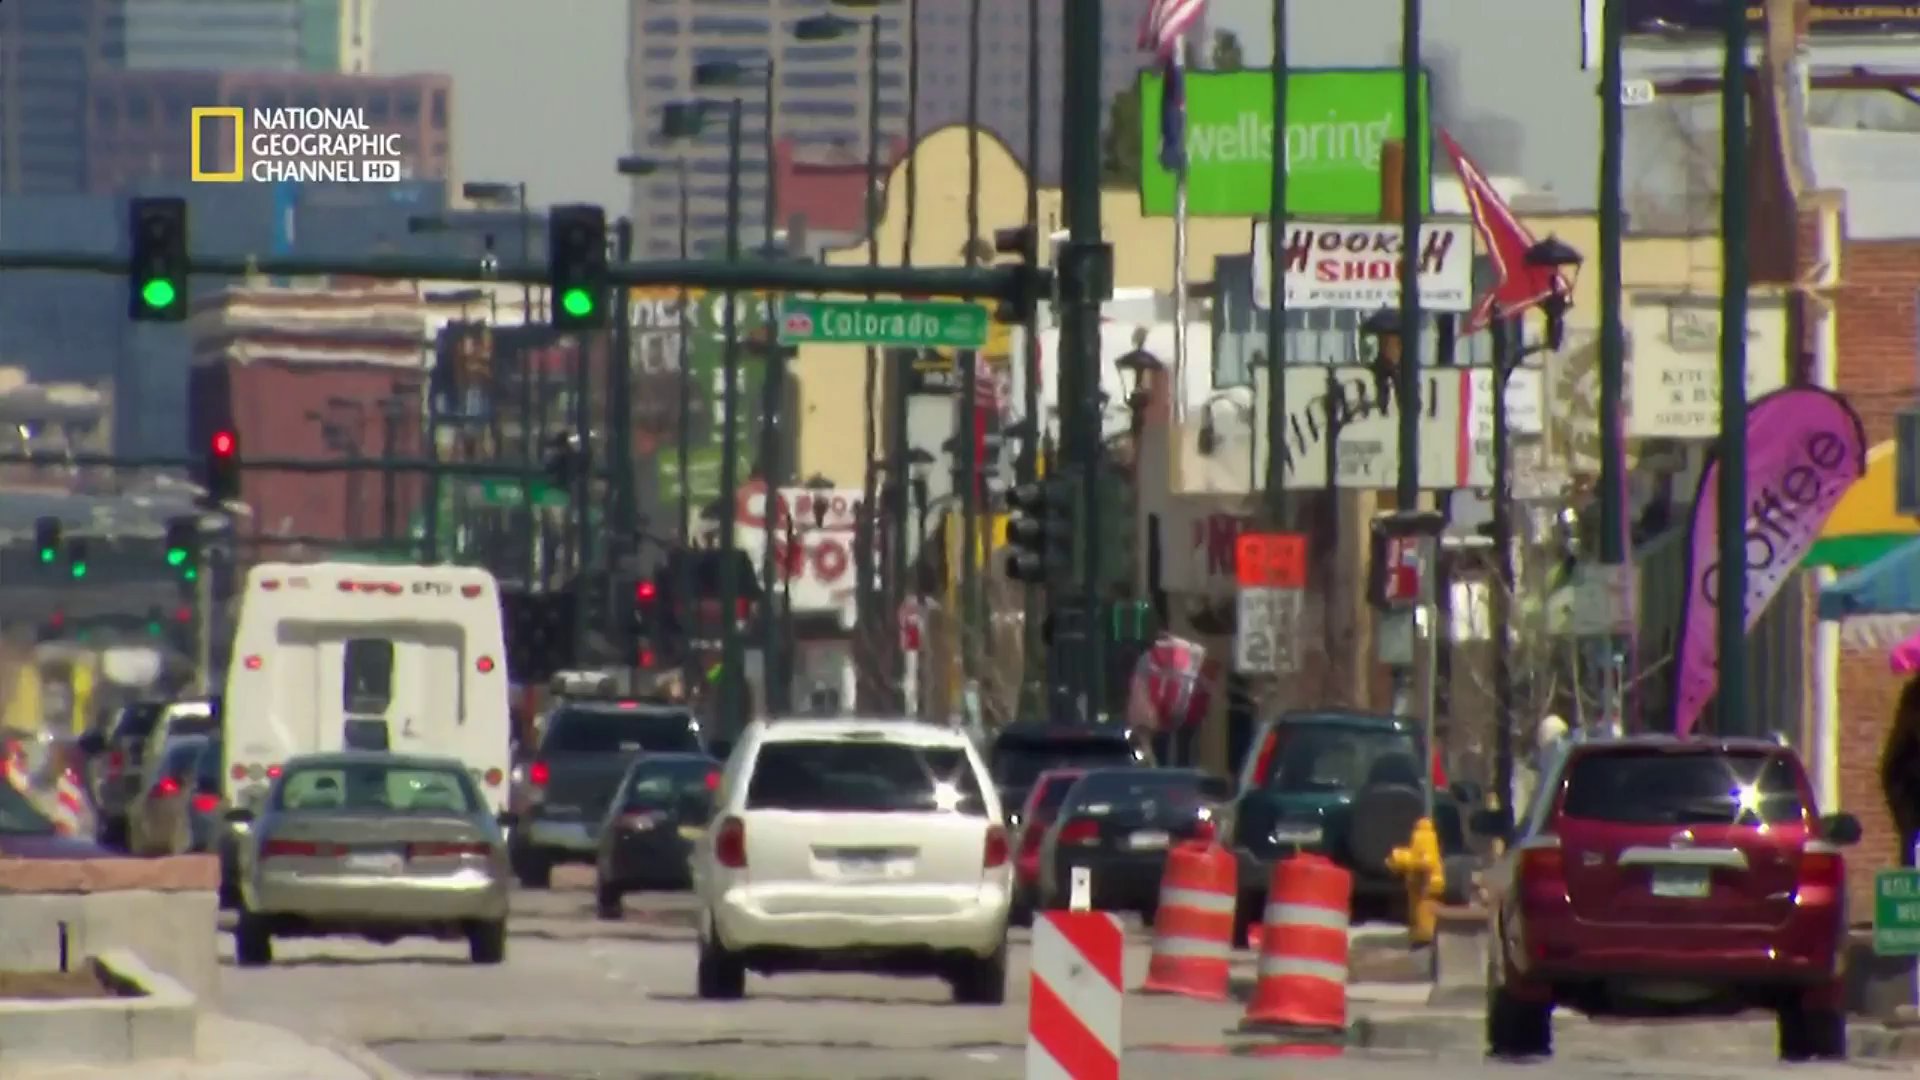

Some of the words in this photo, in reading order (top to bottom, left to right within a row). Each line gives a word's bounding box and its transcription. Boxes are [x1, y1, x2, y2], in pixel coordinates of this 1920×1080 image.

[1187, 109, 1393, 174] wellspring
[1284, 229, 1454, 274] HOOKH
[1314, 258, 1403, 282] SHO
[821, 308, 941, 338] Colorado
